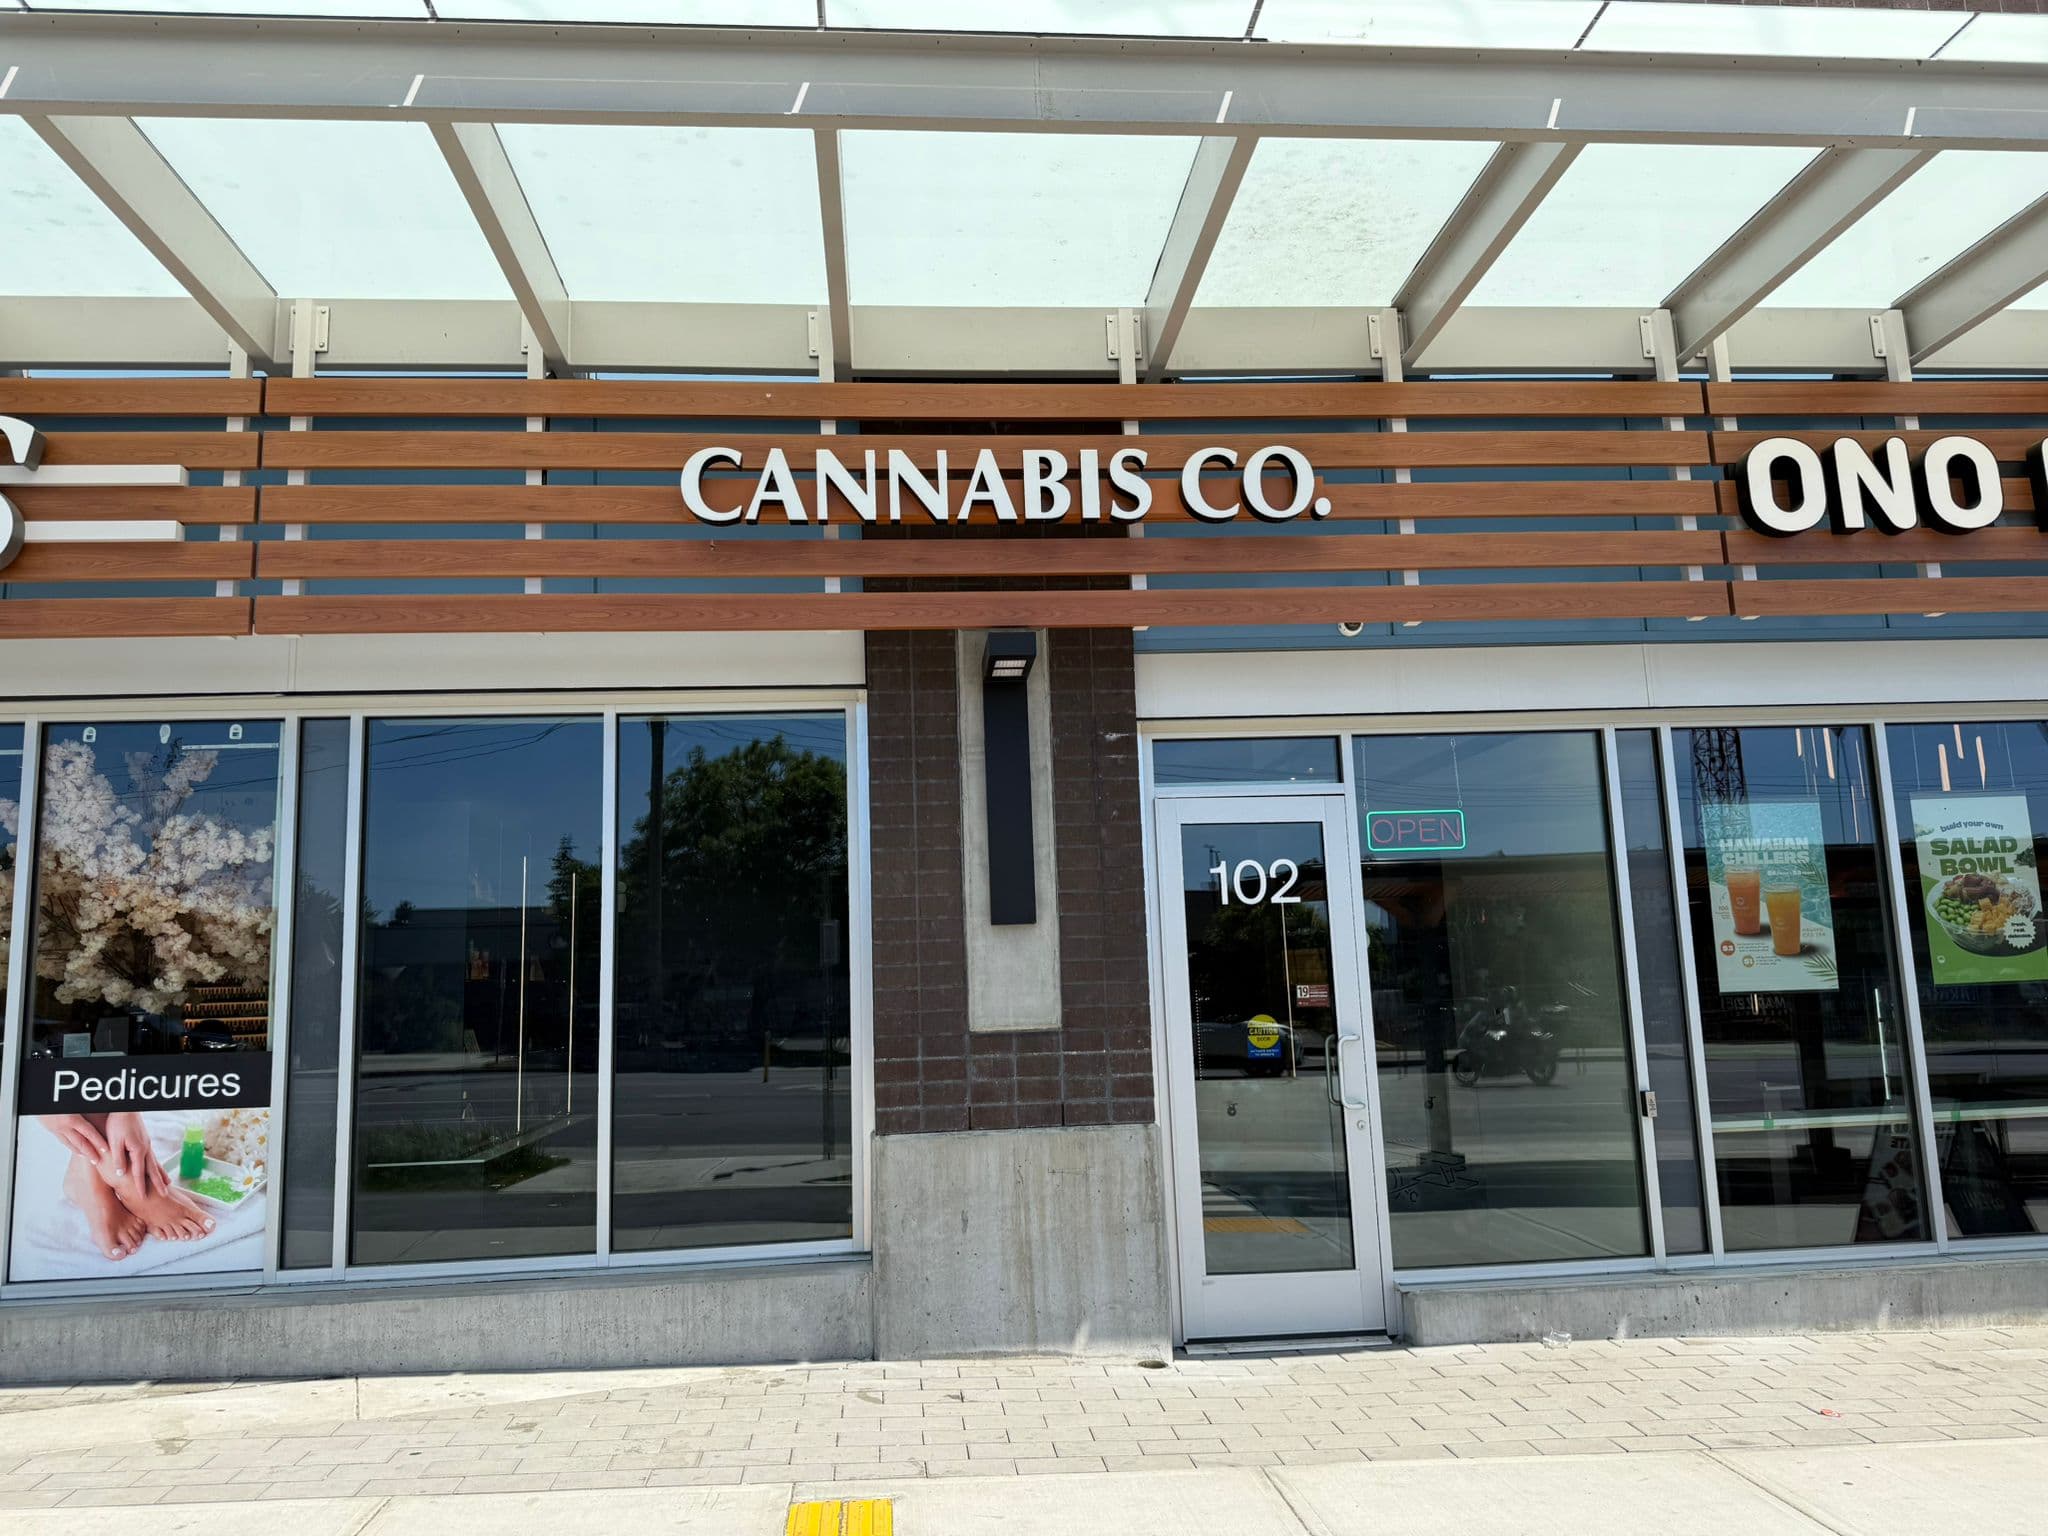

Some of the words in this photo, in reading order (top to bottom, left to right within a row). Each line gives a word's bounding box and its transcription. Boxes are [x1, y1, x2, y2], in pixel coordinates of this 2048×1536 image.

[680, 447, 1152, 521] CANNABIS
[1181, 445, 1332, 520] CO.
[1745, 435, 2004, 532] ONO
[1371, 818, 1462, 844] OPEN
[1939, 821, 1962, 832] build
[1963, 820, 1984, 829] your
[1984, 821, 2004, 831] own
[1930, 836, 2018, 856] SALAD
[1722, 851, 1810, 865] CHILLERS
[1940, 857, 2014, 875] BOWL
[1208, 858, 1301, 905] 102
[1298, 986, 1309, 998] 19
[1249, 1027, 1279, 1035] CAUTION
[52, 1068, 241, 1102] Pedicures
